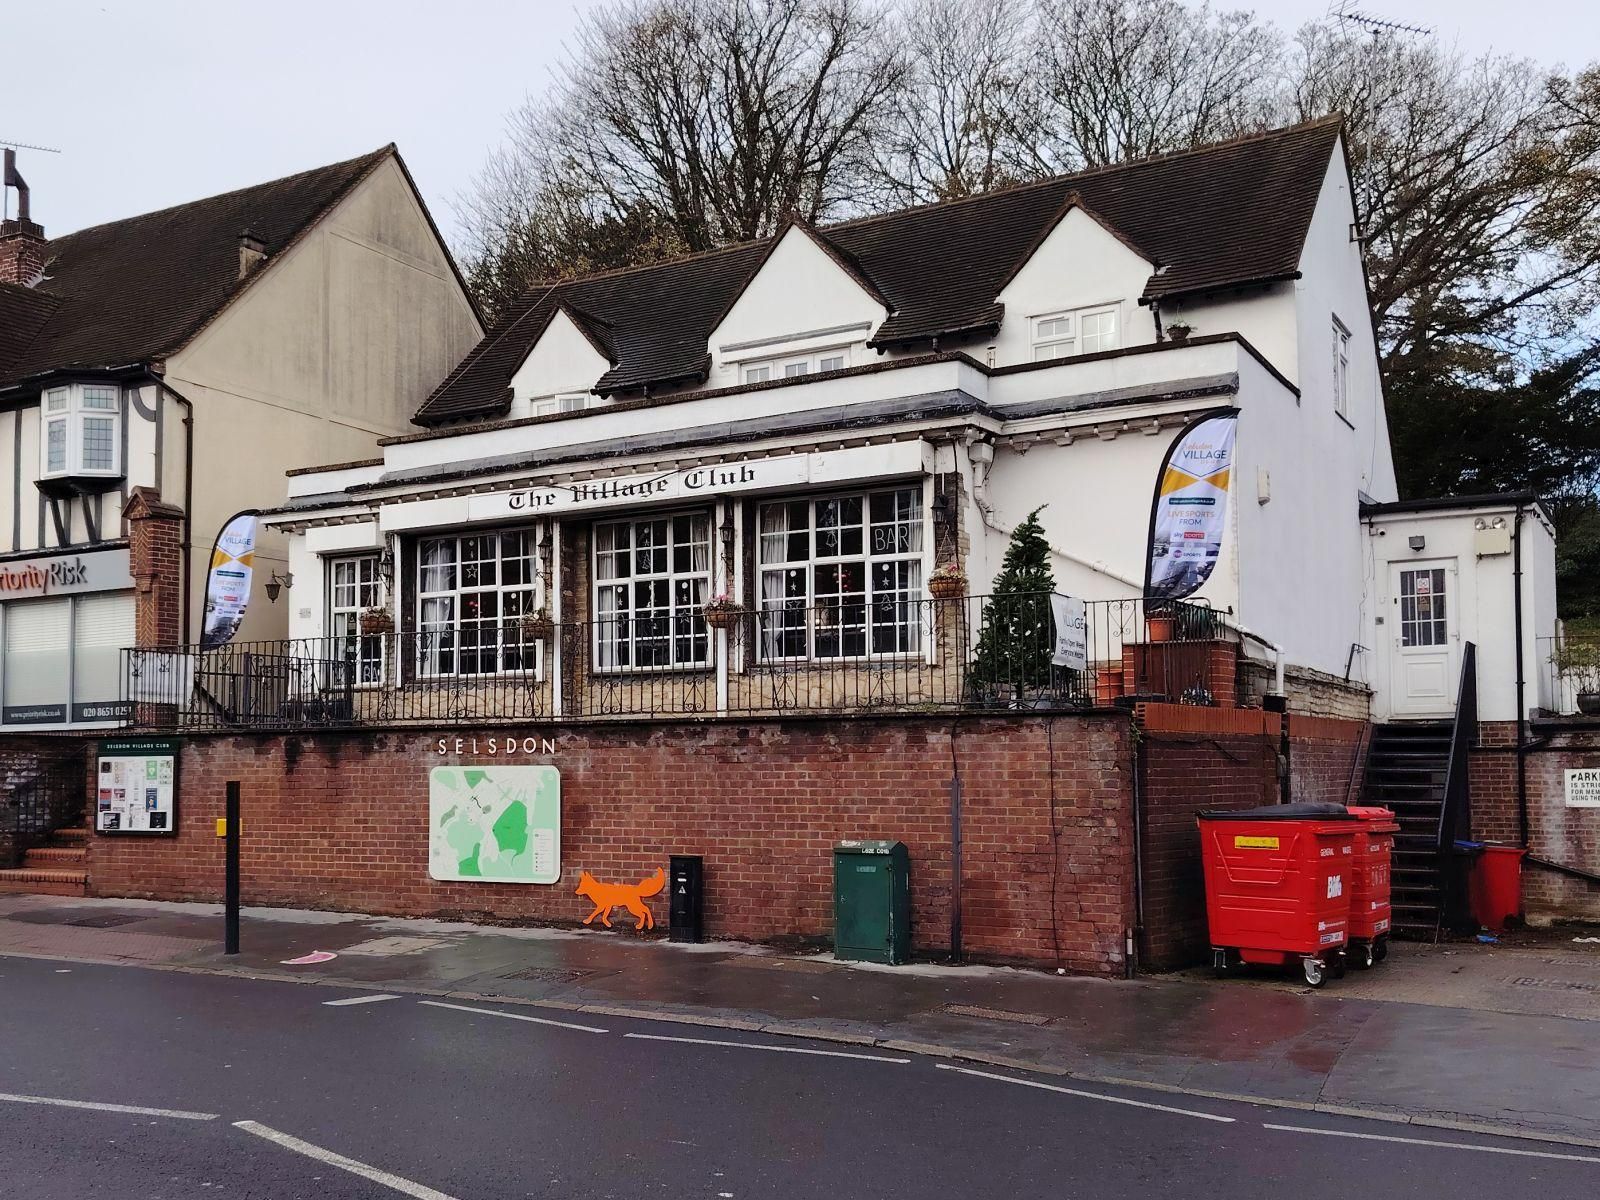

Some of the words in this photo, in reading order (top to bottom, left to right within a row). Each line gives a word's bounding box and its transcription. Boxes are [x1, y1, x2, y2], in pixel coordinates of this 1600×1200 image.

[1183, 450, 1227, 459] VILLAGE
[508, 490, 556, 510] The
[570, 478, 668, 503] Village
[684, 465, 755, 489] Club
[874, 526, 909, 551] BAR
[83, 708, 96, 718] 020
[97, 707, 114, 717] 8651
[437, 737, 556, 755] SELSDON
